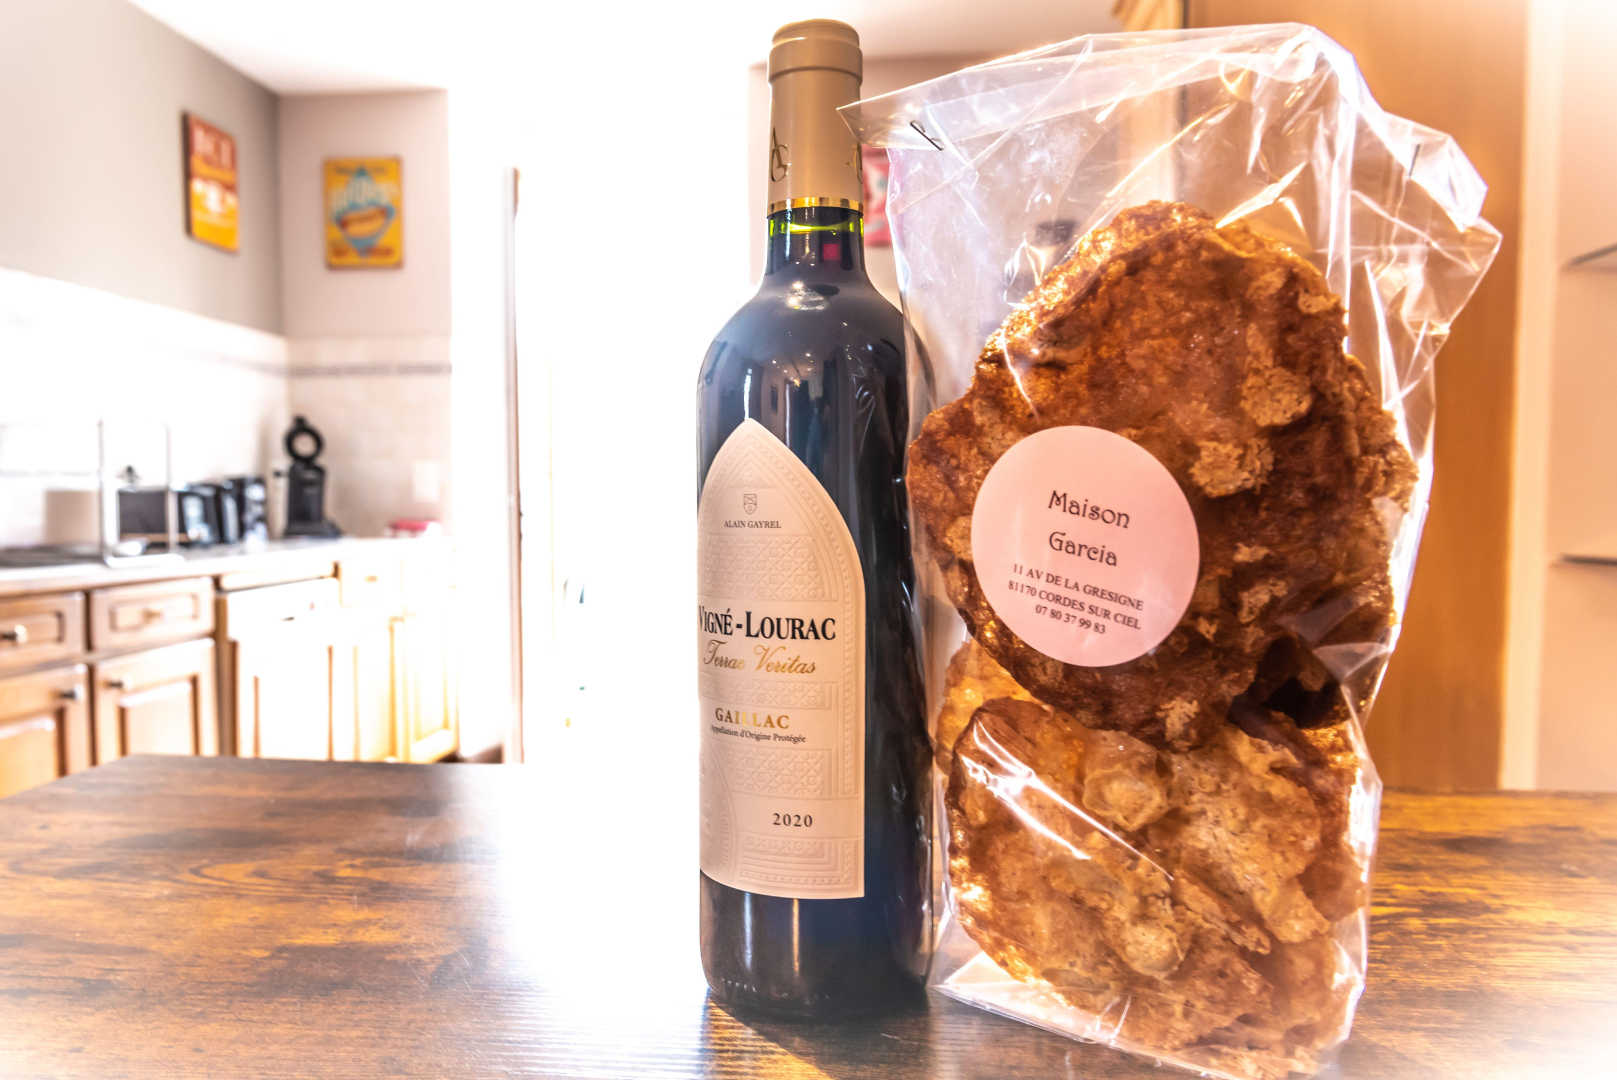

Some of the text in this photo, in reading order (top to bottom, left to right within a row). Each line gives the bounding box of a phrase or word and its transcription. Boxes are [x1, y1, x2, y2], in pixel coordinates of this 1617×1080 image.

[724, 520, 782, 529] ALAIN GAYREL
[1048, 490, 1131, 529] Maison
[1048, 531, 1118, 567] Garcia
[1013, 563, 1144, 611] 11 AV DE LA GRESIGNE
[1008, 580, 1142, 630] 81170 CORDES SUR CIEL
[1035, 604, 1049, 616] 07
[1064, 613, 1077, 625] 37
[1079, 618, 1092, 630] 99
[703, 640, 816, 674] Terrae Veritas
[715, 707, 790, 729] GAILLAC
[772, 812, 813, 828] 2020
